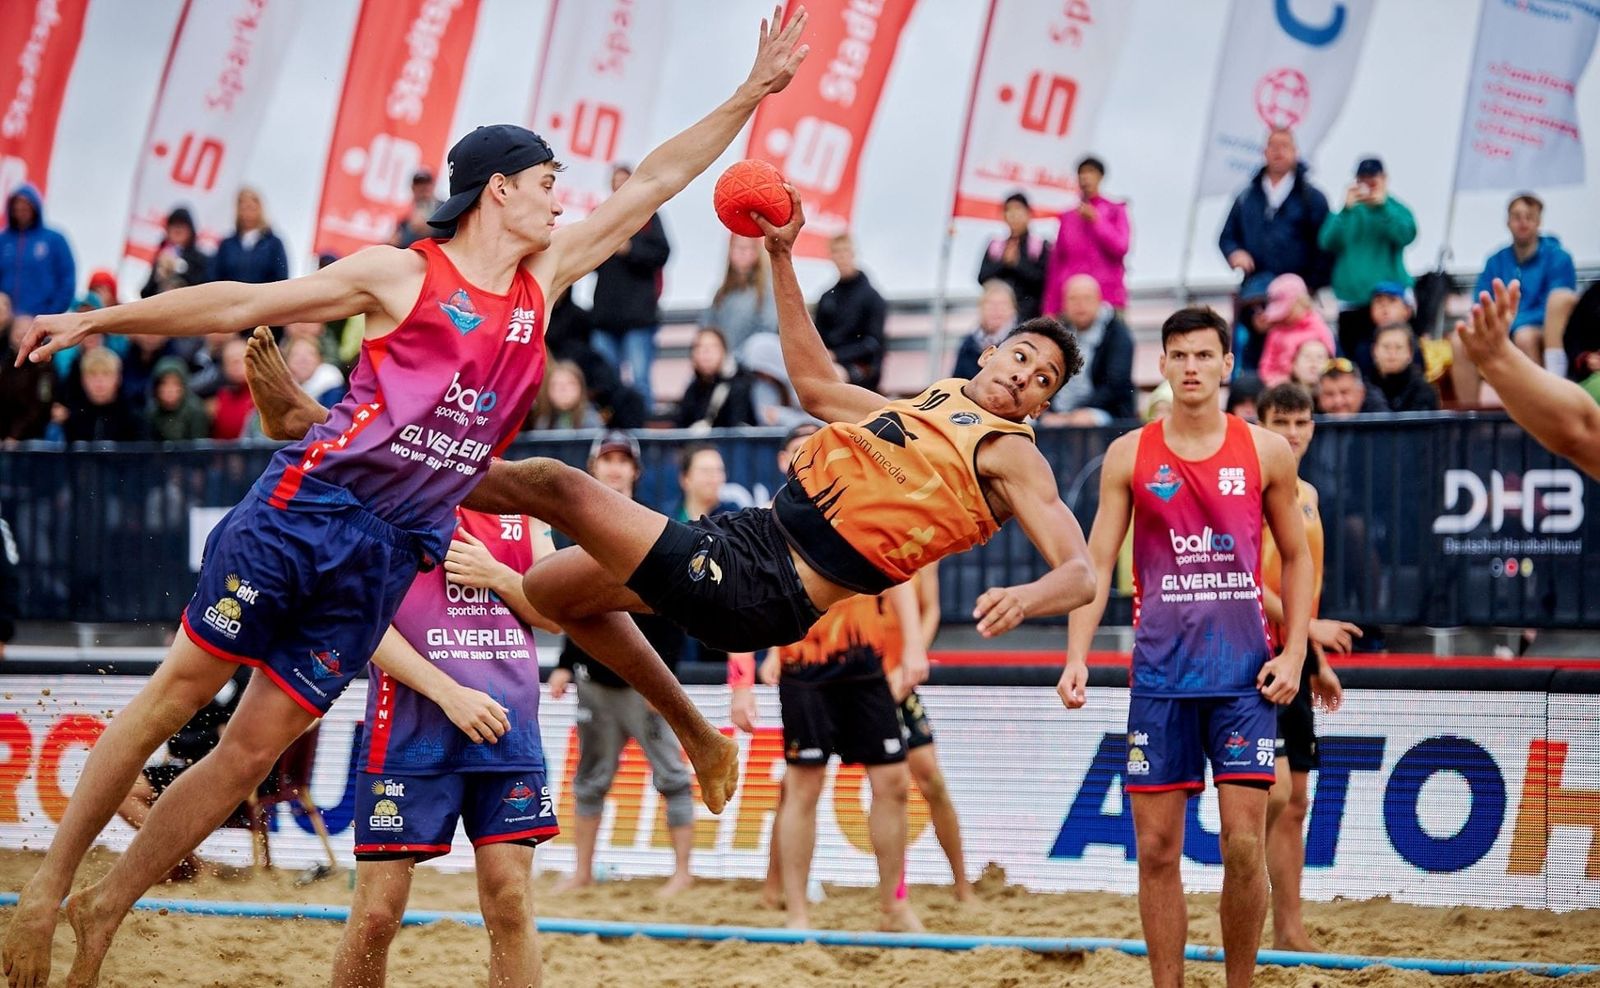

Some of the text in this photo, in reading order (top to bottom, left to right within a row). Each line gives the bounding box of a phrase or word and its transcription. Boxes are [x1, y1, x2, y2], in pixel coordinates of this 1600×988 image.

[505, 321, 533, 344] 23
[872, 451, 907, 485] media
[1219, 467, 1246, 477] GER
[1218, 480, 1246, 496] 92
[1432, 469, 1585, 534] DHB
[501, 523, 523, 541] 20
[1169, 525, 1235, 554] ballco
[236, 585, 259, 605] ebt
[446, 604, 488, 618] sportlich
[204, 606, 241, 634] GBO
[428, 650, 449, 660] WO
[450, 650, 470, 659] WIR
[470, 650, 493, 660] SIND
[495, 650, 509, 659] IST
[1126, 760, 1150, 772] GBO
[1256, 750, 1274, 767] 92
[385, 782, 405, 797] ebt
[369, 815, 404, 827] GBO
